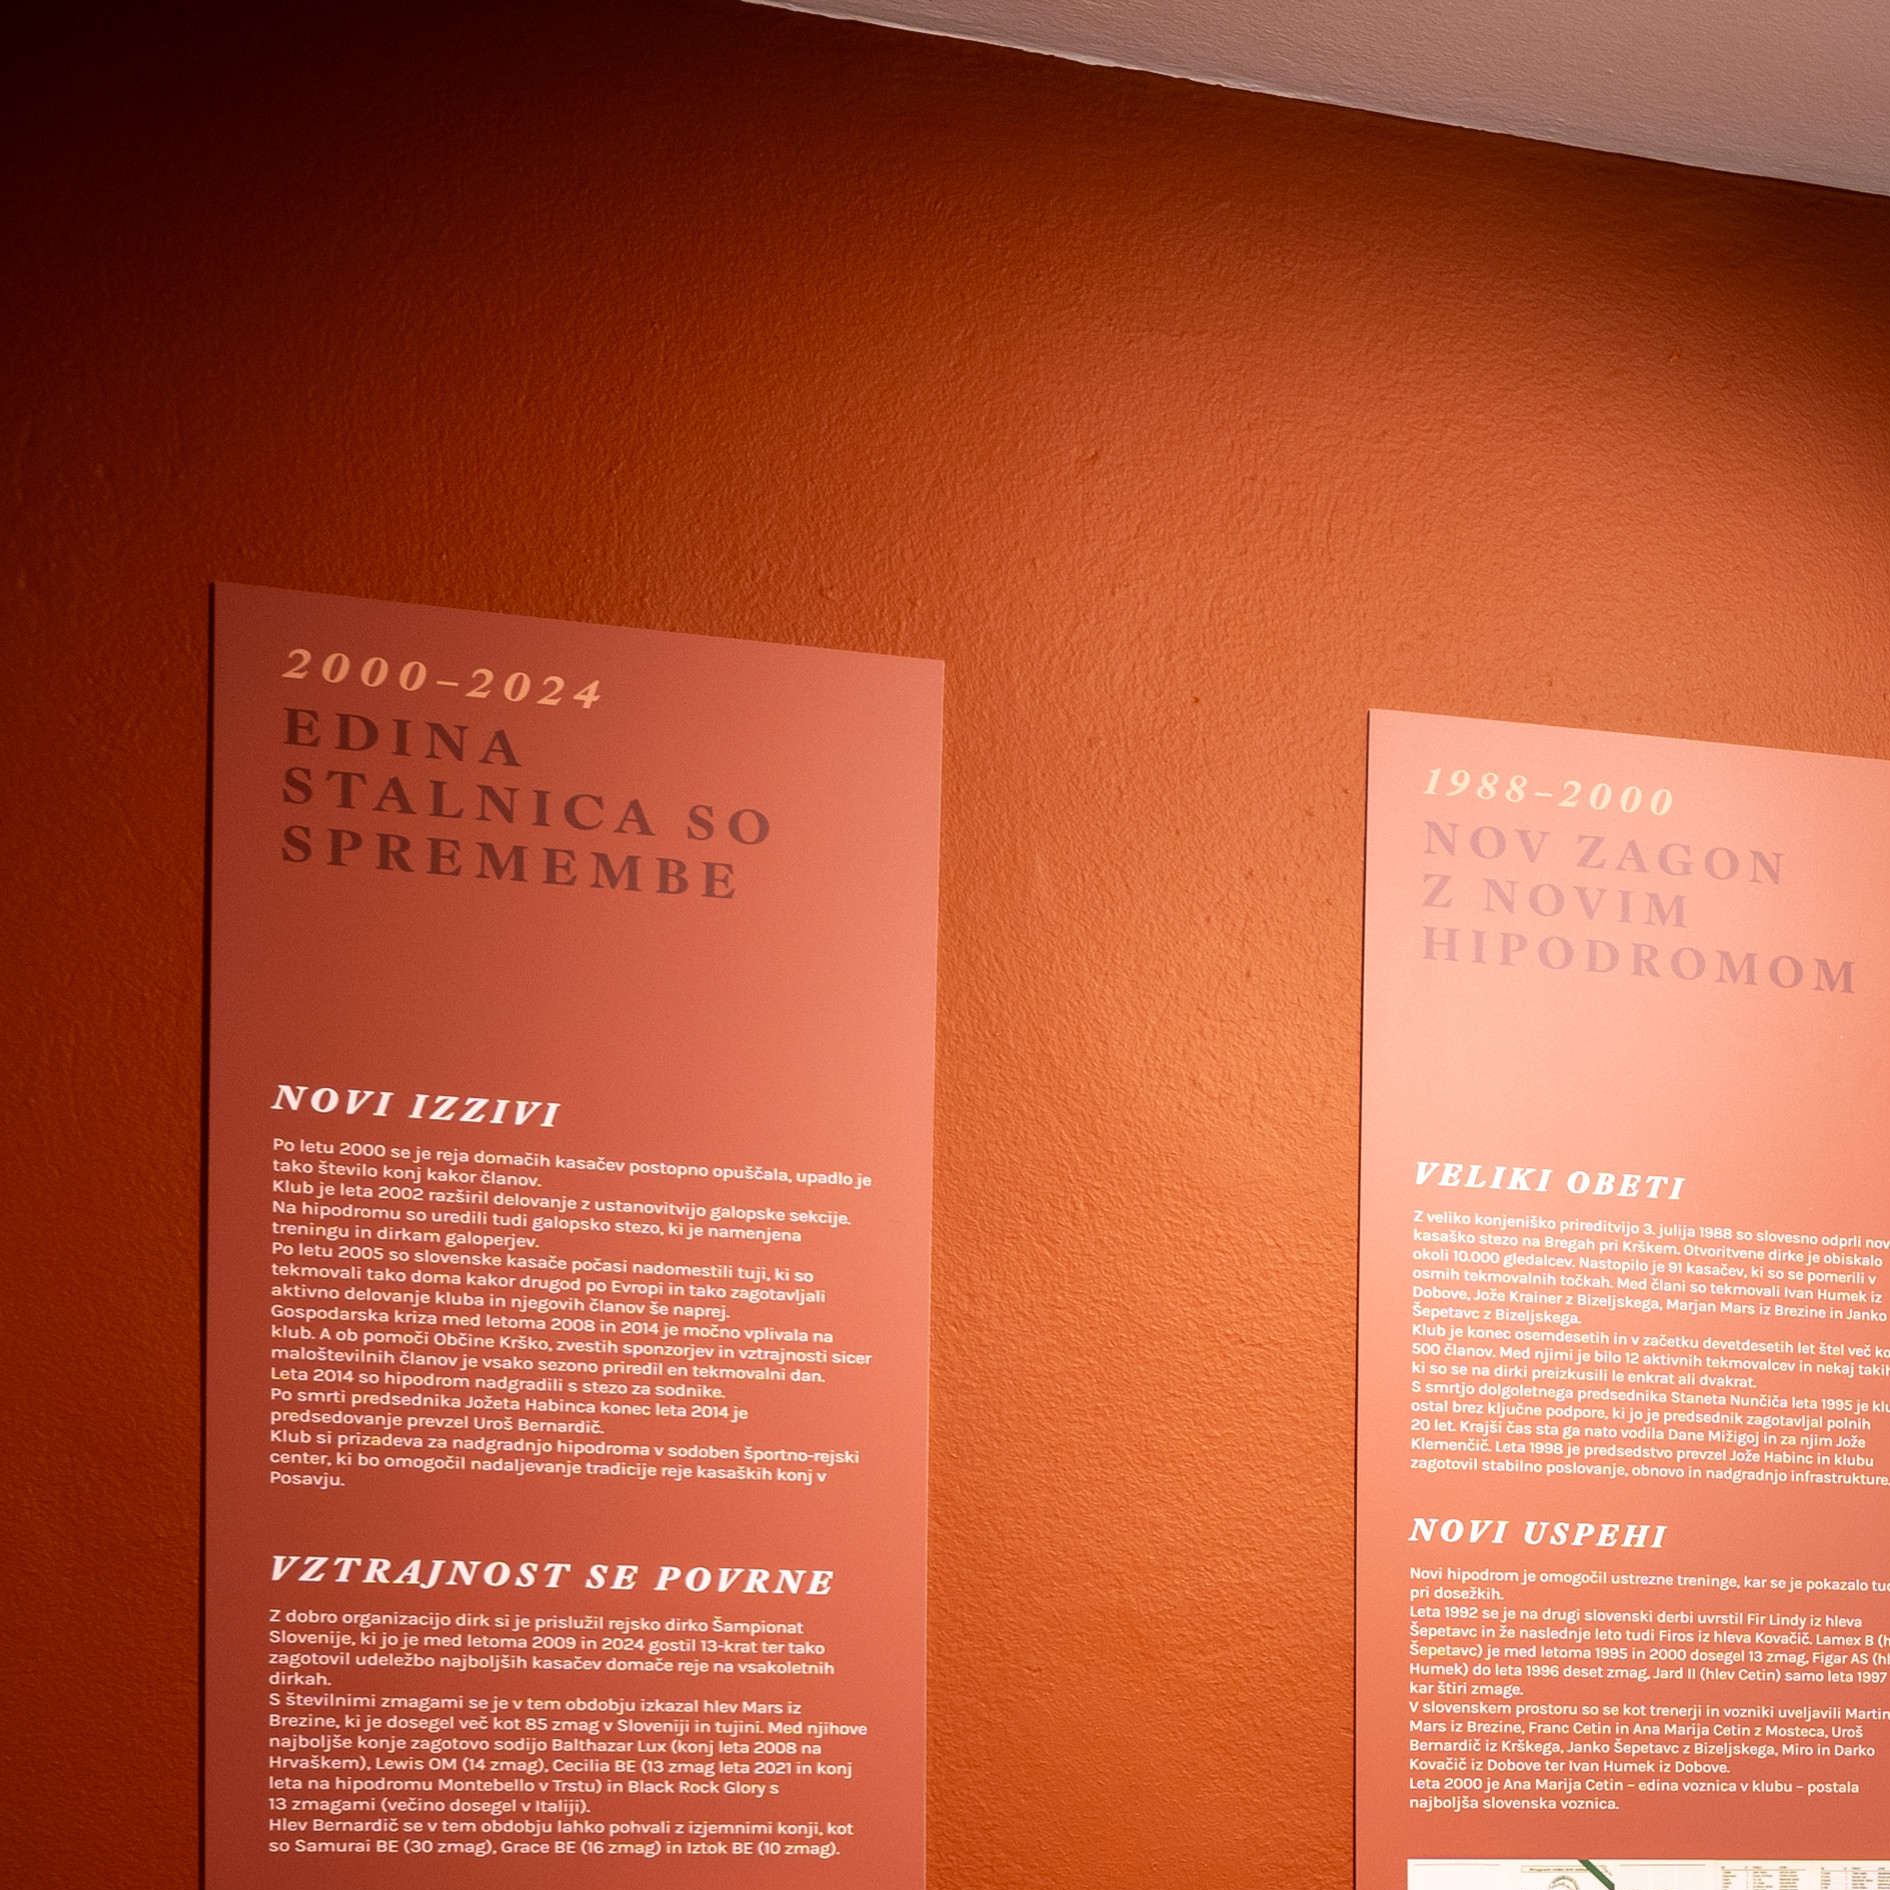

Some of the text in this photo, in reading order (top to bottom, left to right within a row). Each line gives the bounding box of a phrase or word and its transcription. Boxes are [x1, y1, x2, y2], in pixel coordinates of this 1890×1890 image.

[282, 649, 600, 708] 2000–2024
[285, 708, 520, 767] EDINA
[283, 767, 769, 844] STALNICA SO
[1423, 768, 1672, 815] 1988–2000
[282, 825, 734, 899] SPREMEMBE
[1424, 821, 1782, 884] NOV ZAGON
[1423, 873, 1685, 927] Z NOVIM
[1424, 926, 1853, 993] HIPODROMOM
[271, 1085, 560, 1126] NOVI IZZIVI
[273, 1159, 540, 1186] tako število konj kakor članov.
[1416, 1162, 1684, 1199] VELIKI OBETI
[272, 1222, 538, 1250] treningu in dirkam galoperjev.
[1412, 1302, 1581, 1327] Šepetavc z Bizeljskega.
[270, 1471, 344, 1489] Posavju.
[1408, 1518, 1667, 1547] NOVI USPEHI
[272, 1556, 832, 1594] VZTRAJNOST SE POVRNE
[1410, 1586, 1503, 1601] pri dosežkih.
[1410, 1681, 1523, 1698] kar štiri zmage.
[1410, 1796, 1619, 1811] najboljša slovenska voznica.
